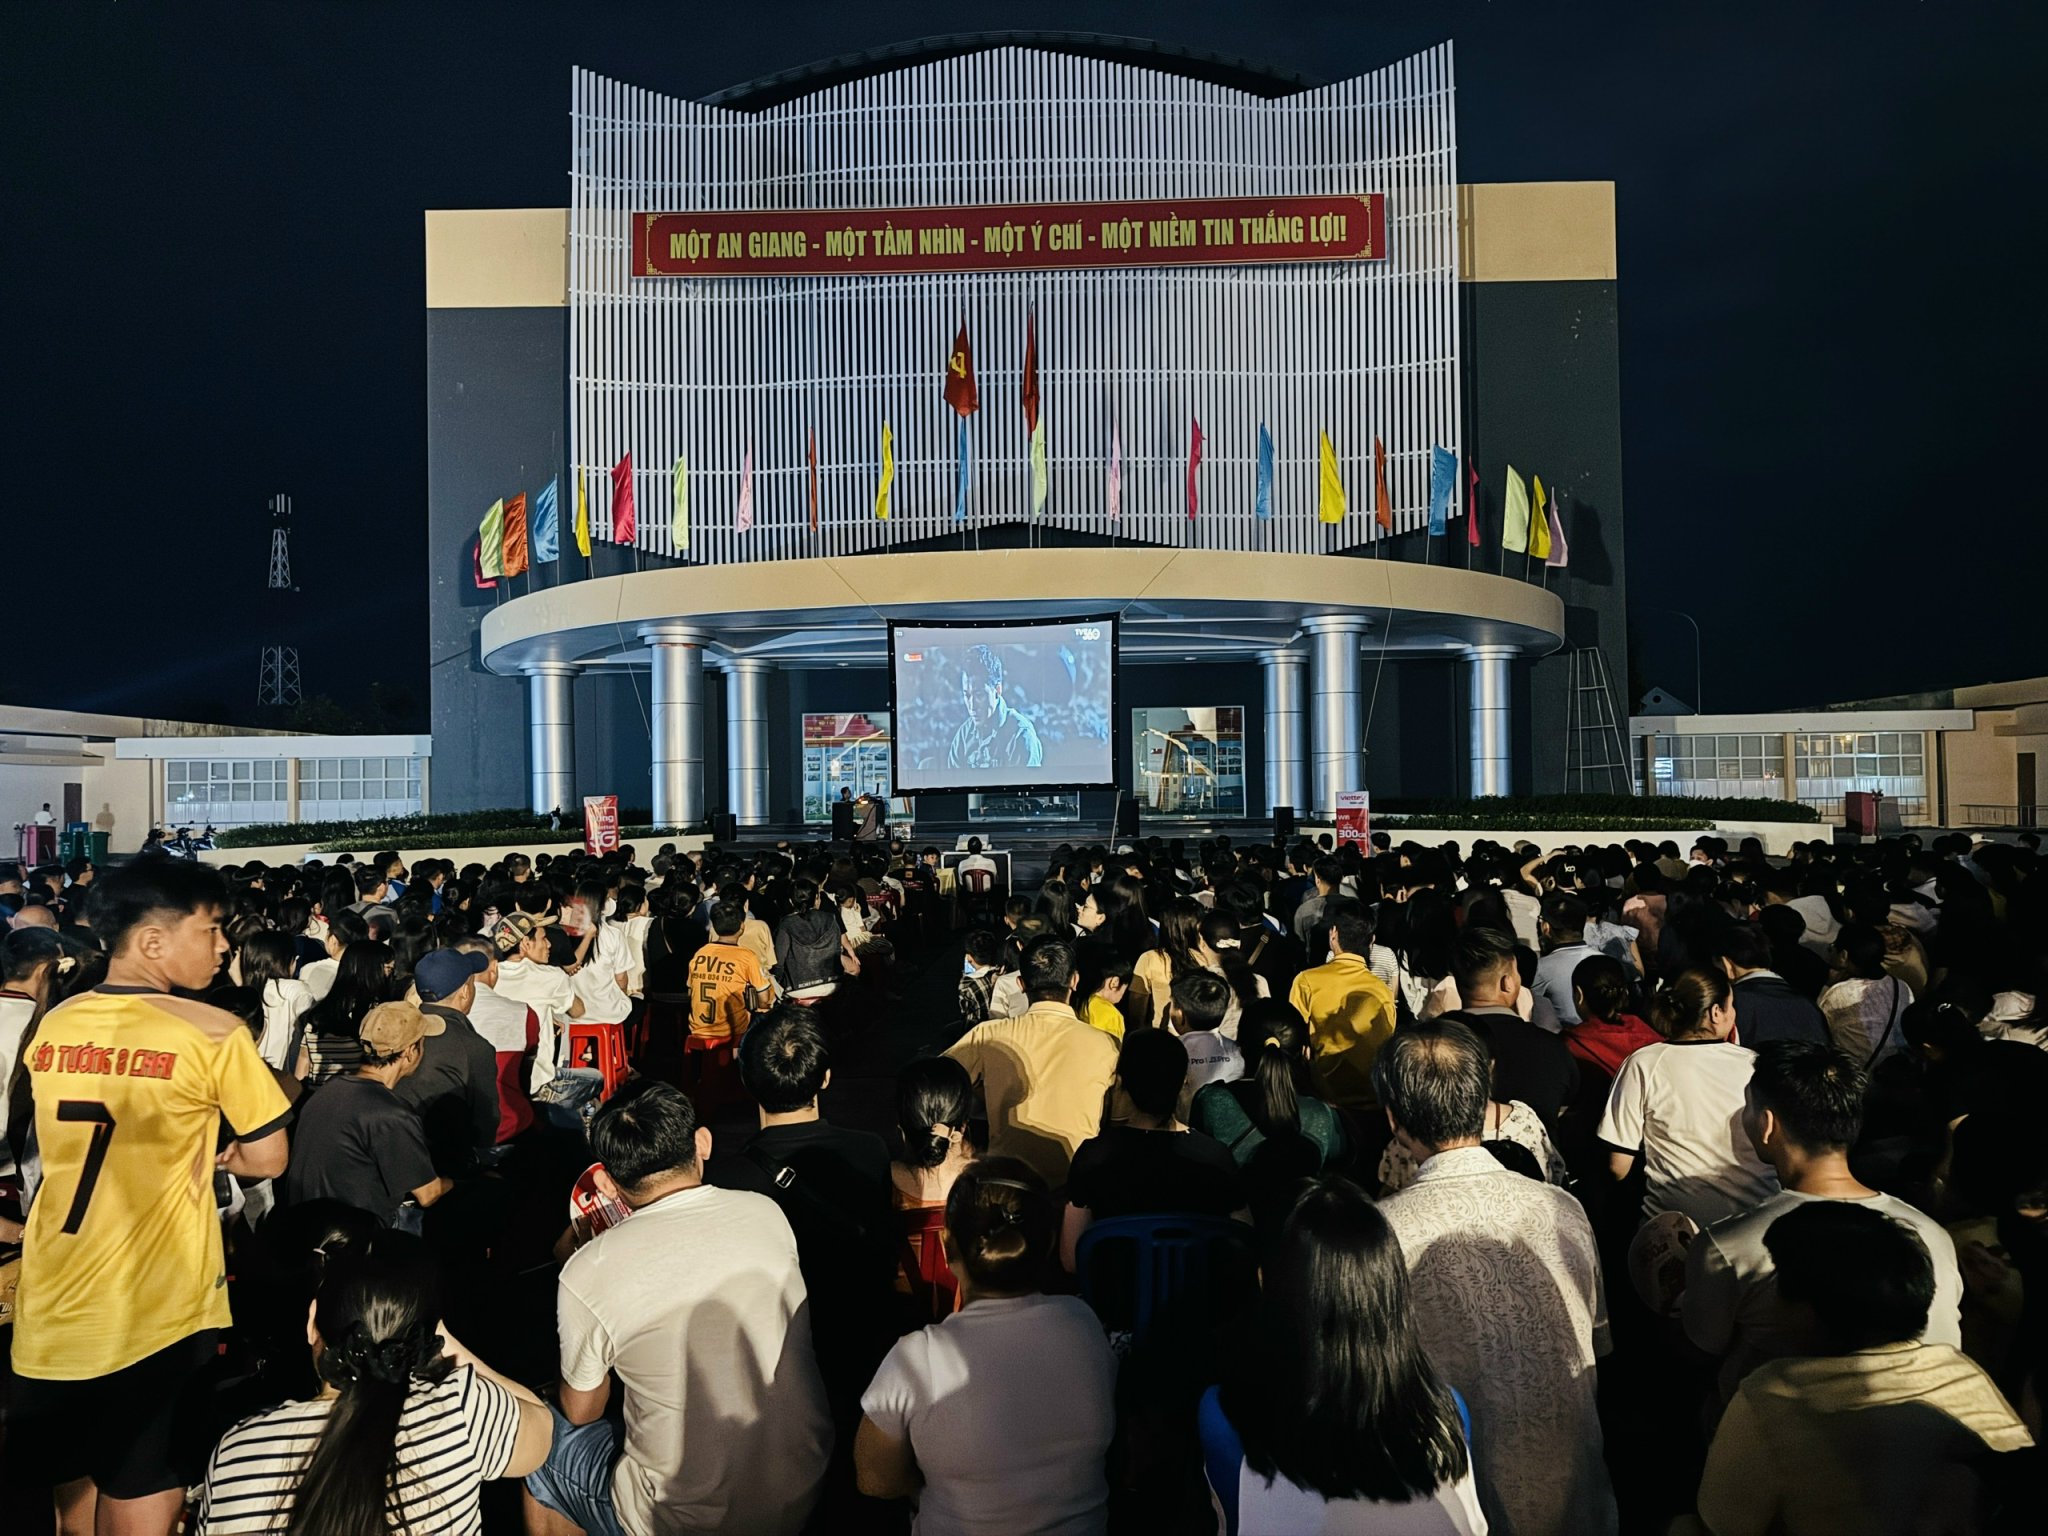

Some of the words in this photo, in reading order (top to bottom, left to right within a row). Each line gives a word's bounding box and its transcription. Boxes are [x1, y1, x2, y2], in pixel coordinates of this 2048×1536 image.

[670, 229, 711, 264] MỘT
[717, 232, 742, 258] AN
[748, 231, 807, 258] GIANG
[826, 226, 867, 262] MỘT
[872, 220, 913, 256] TẦM
[919, 223, 965, 255] NHÌN
[984, 220, 1026, 258] MỘT
[1030, 220, 1043, 251] Ý
[1048, 218, 1083, 251] CHÍ
[1101, 217, 1144, 254] MỘT
[1149, 211, 1197, 248] NIỀM
[1202, 218, 1234, 246] TIN
[1240, 209, 1304, 245] THẮNG
[1310, 212, 1347, 248] LỢI!
[699, 982, 717, 1025] 5
[57, 1100, 117, 1235] 7
